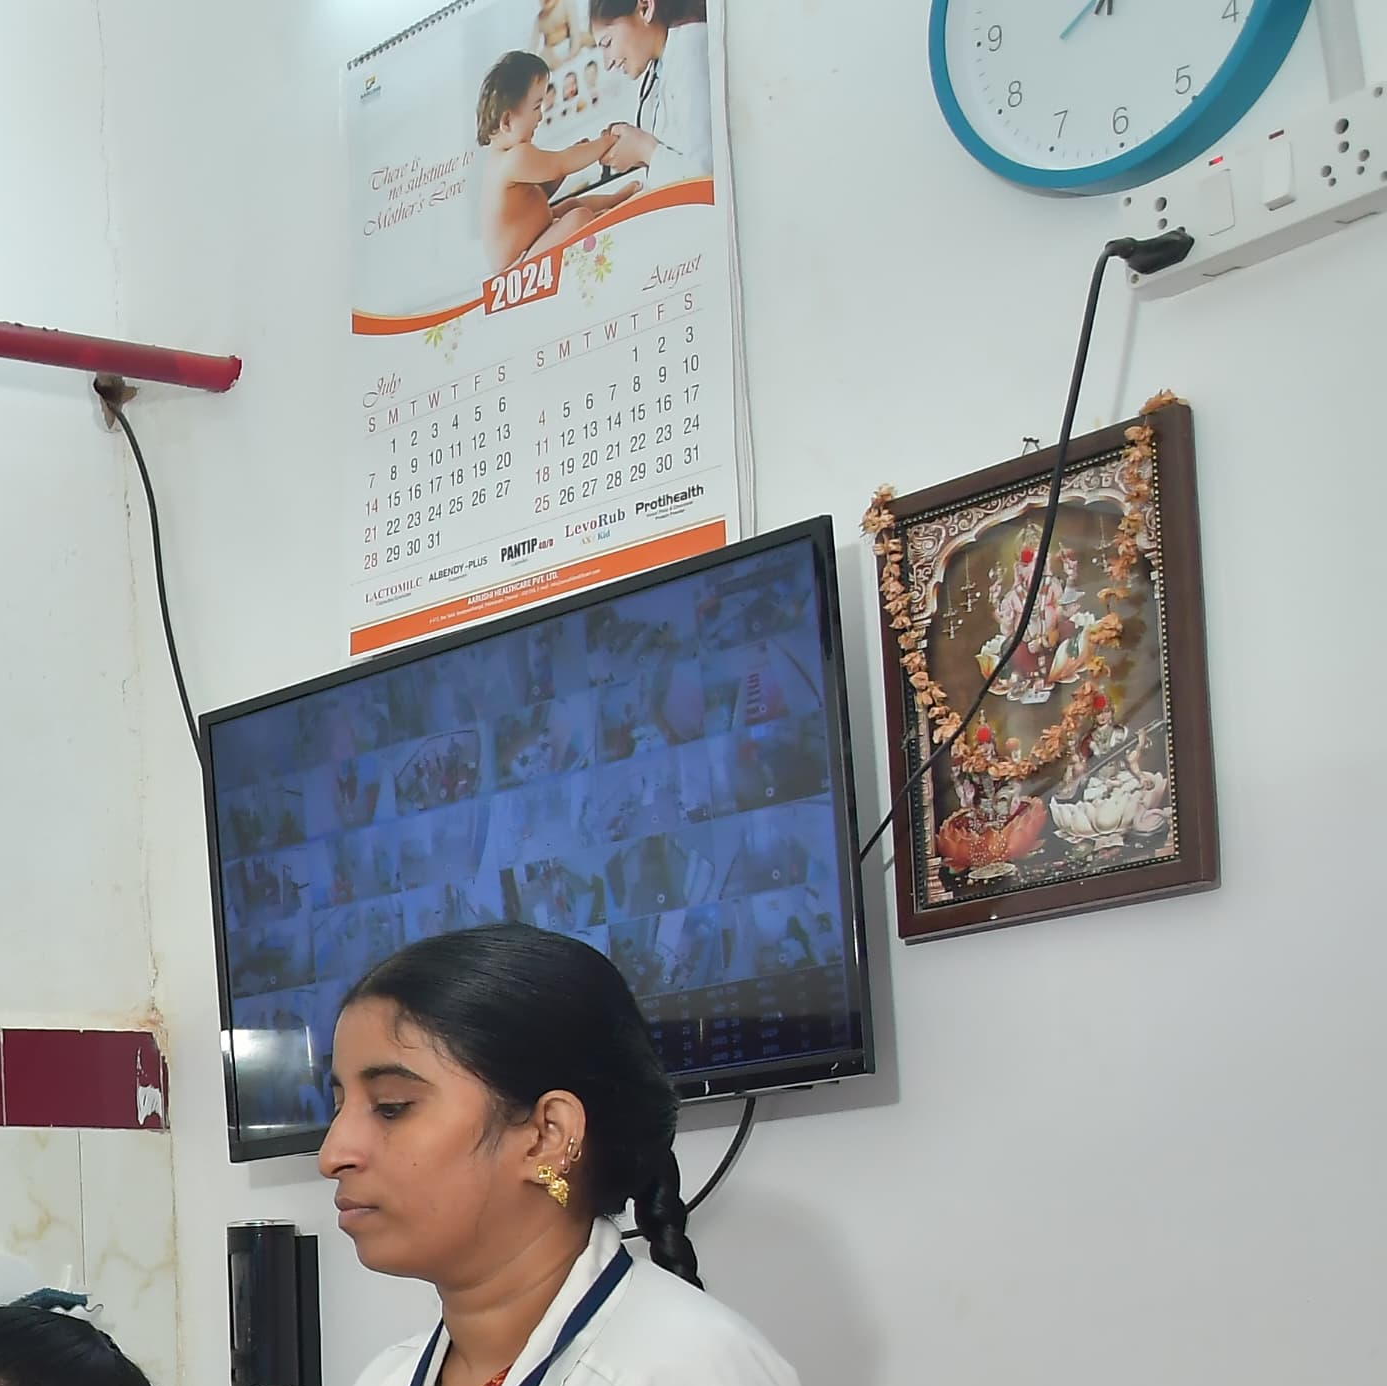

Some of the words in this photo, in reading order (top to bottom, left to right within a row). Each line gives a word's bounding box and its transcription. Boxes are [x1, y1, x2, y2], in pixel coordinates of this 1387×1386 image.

[987, 24, 1003, 52] 9
[1007, 80, 1023, 108] 8
[1175, 64, 1192, 95] 5
[1053, 109, 1068, 139] 7
[1112, 106, 1129, 135] 6
[371, 165, 409, 190] There
[388, 187, 402, 200] no
[405, 157, 459, 194] substitute
[462, 152, 474, 167] to
[491, 256, 554, 311] 2024
[642, 253, 701, 292] August
[537, 351, 544, 367] S
[560, 340, 570, 359] M
[583, 332, 591, 348] T
[605, 322, 617, 340] W
[630, 313, 639, 330] T
[658, 304, 664, 320] F
[685, 293, 692, 310] S
[633, 346, 637, 362] 1
[658, 336, 665, 353] 2
[686, 326, 693, 343] 3
[363, 373, 401, 408] July
[369, 417, 375, 432] S
[389, 408, 398, 424] M
[410, 400, 417, 416] T
[429, 391, 440, 408] W
[451, 384, 458, 400] T
[475, 375, 481, 391] F
[498, 366, 505, 382] S
[539, 410, 545, 426] 4
[563, 401, 570, 418] 5
[586, 393, 593, 409] 6
[609, 384, 616, 400] 7
[633, 376, 640, 392] 8
[659, 366, 666, 383] 9
[683, 355, 699, 374] 10
[391, 438, 395, 453] 1
[411, 431, 417, 446] 2
[432, 423, 438, 438] 3
[452, 414, 458, 429] 4
[475, 406, 481, 422] 5
[499, 397, 506, 412] 6
[535, 438, 547, 456] 11
[560, 429, 575, 447] 12
[583, 421, 597, 439] 13
[607, 412, 621, 431] 14
[631, 403, 645, 422] 15
[656, 394, 671, 413] 16
[684, 384, 699, 404] 17
[369, 473, 375, 488] 7
[391, 465, 397, 480] 8
[411, 458, 417, 473] 9
[429, 449, 442, 466] 10
[449, 441, 461, 458] 11
[472, 432, 485, 450] 12
[497, 424, 510, 441] 13
[536, 466, 549, 484] 18
[560, 458, 574, 476] 19
[582, 450, 597, 468] 20
[606, 442, 619, 460] 21
[630, 433, 646, 453] 22
[656, 424, 671, 444] 23
[684, 414, 699, 434] 24
[366, 498, 377, 516] 14
[388, 491, 400, 508] 15
[409, 484, 421, 501] 16
[429, 476, 442, 494] 17
[450, 469, 463, 486] 18
[473, 460, 486, 478] 19
[497, 452, 511, 470] 20
[535, 494, 549, 513] 25
[560, 486, 574, 505] 26
[582, 478, 597, 498] 27
[607, 471, 621, 490] 28
[630, 463, 646, 482] 29
[656, 454, 672, 473] 30
[684, 444, 698, 464] 31
[365, 526, 376, 543] 21
[387, 518, 400, 536] 22
[407, 511, 420, 529] 23
[428, 504, 441, 521] 24
[449, 496, 463, 514] 25
[472, 488, 485, 506] 26
[496, 480, 511, 498] 27
[635, 484, 704, 515] Protihealth
[565, 508, 626, 538] LevoRub
[364, 552, 377, 570] 28
[387, 545, 400, 562] 29
[407, 538, 420, 556] 30
[428, 531, 439, 548] 31
[501, 538, 538, 562] PANTIP
